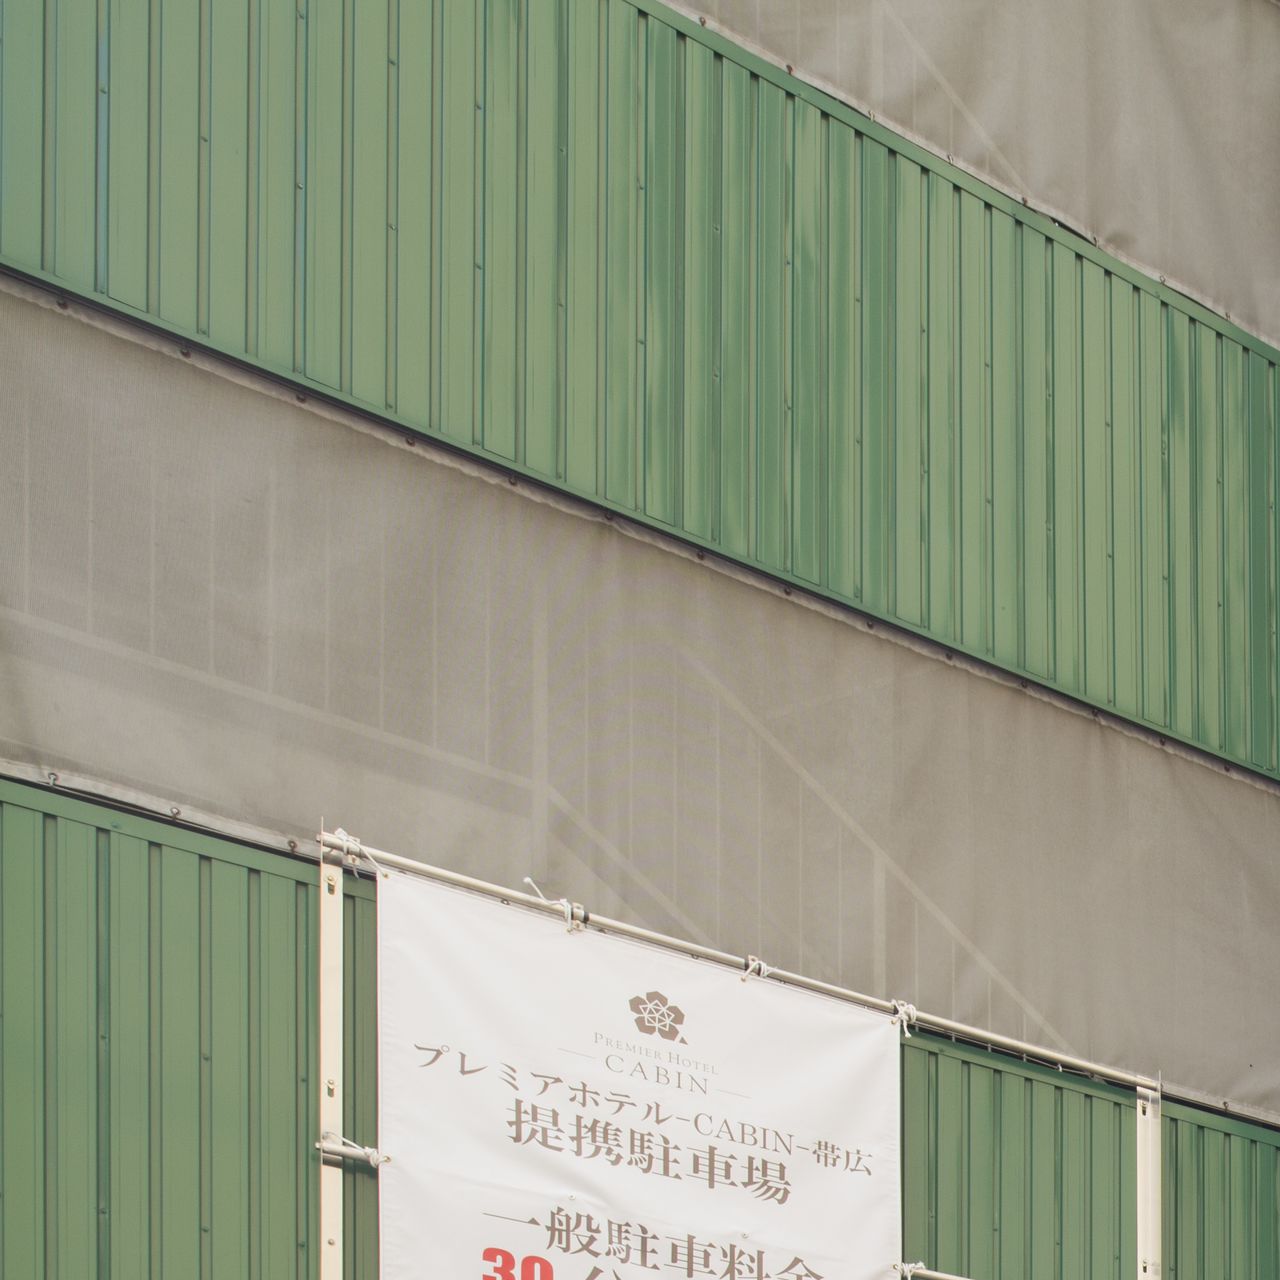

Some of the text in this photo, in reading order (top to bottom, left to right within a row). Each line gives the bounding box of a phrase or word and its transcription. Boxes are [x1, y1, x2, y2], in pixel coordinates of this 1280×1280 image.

[594, 1031, 719, 1075] PREMIER HOTEL
[604, 1054, 709, 1095] CABIN
[506, 1099, 792, 1205] 提携駐車場
